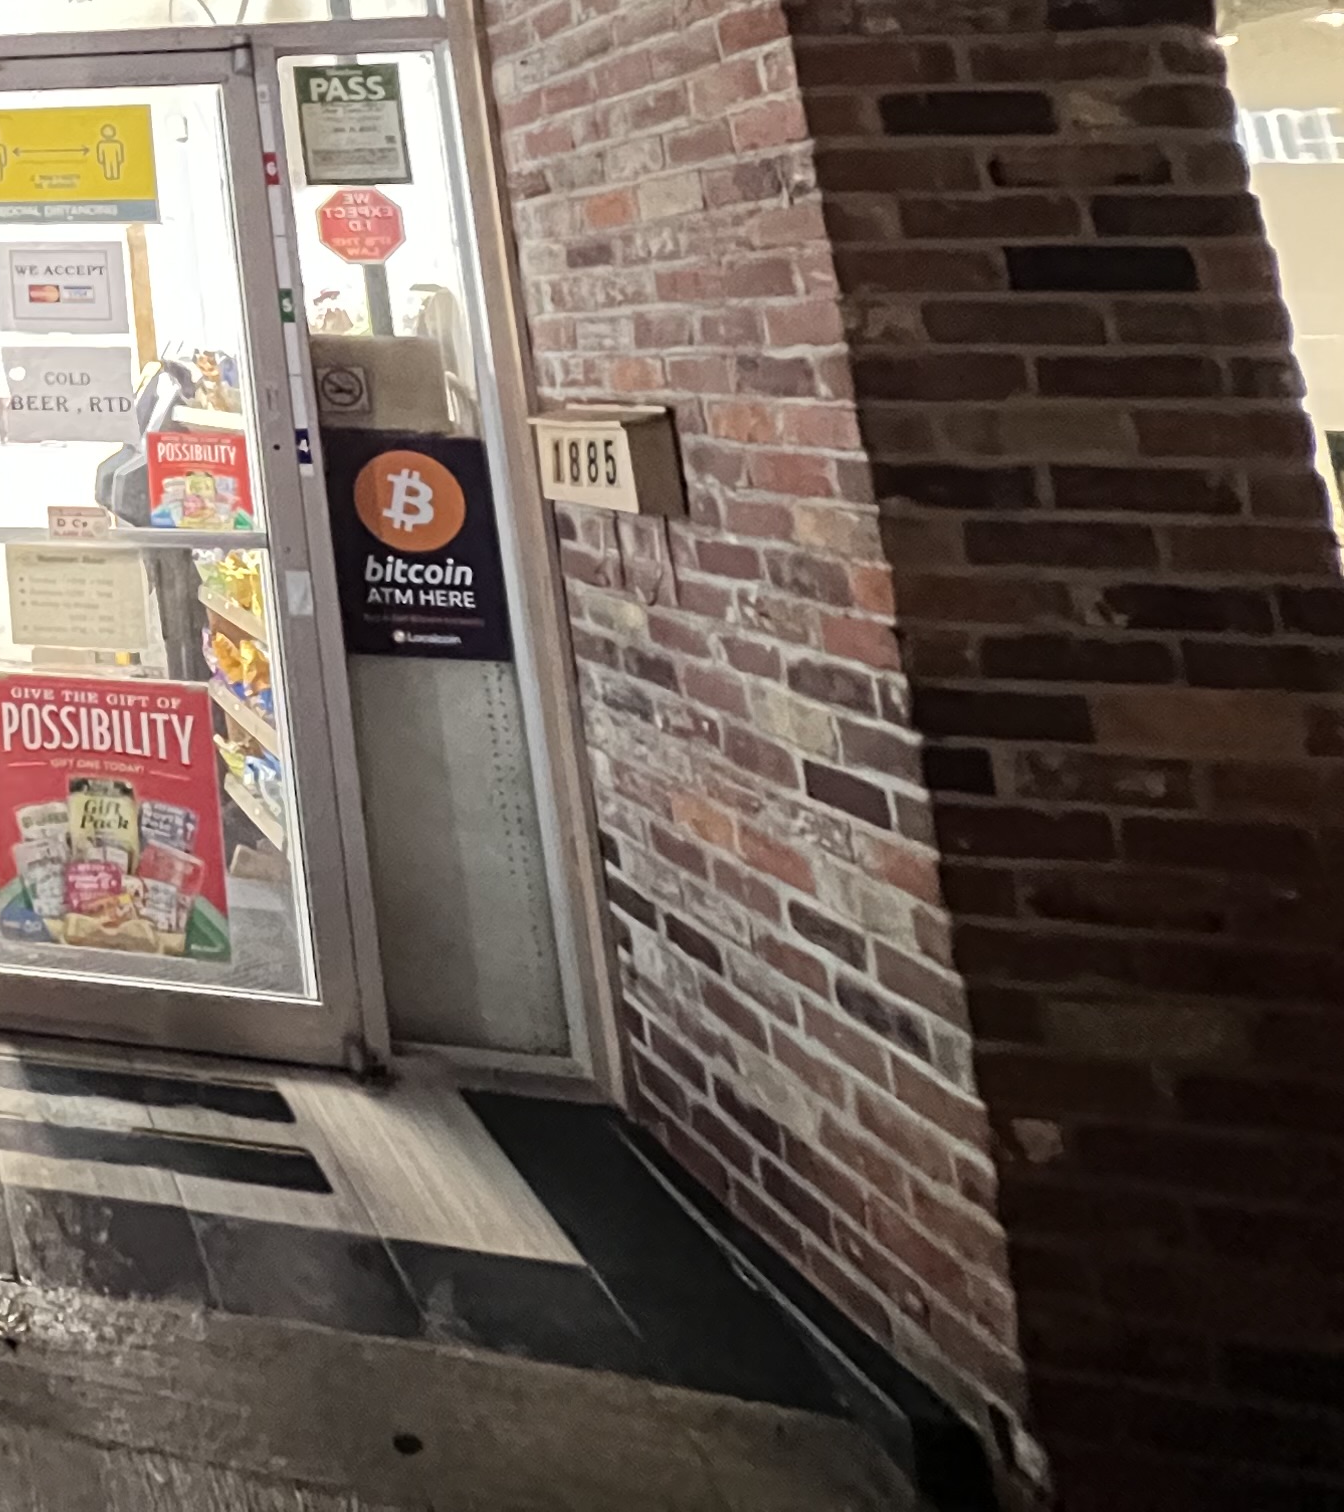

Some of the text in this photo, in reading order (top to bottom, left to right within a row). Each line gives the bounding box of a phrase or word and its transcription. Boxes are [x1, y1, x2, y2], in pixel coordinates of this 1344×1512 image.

[309, 75, 386, 102] PASS
[15, 264, 106, 276] WE ACCEPT
[43, 371, 91, 387] COLD
[12, 395, 70, 413] BEER
[89, 395, 132, 413] RTD
[156, 442, 237, 466] POSSIBILITY
[553, 439, 617, 486] 1885
[365, 555, 474, 586] bitcoin
[367, 587, 477, 608] ATM HERE
[10, 686, 181, 710] GIVE THE GIFT OF
[0, 701, 194, 765] POSSIBILITY
[83, 799, 121, 816] Gift
[79, 815, 130, 831] Pack
